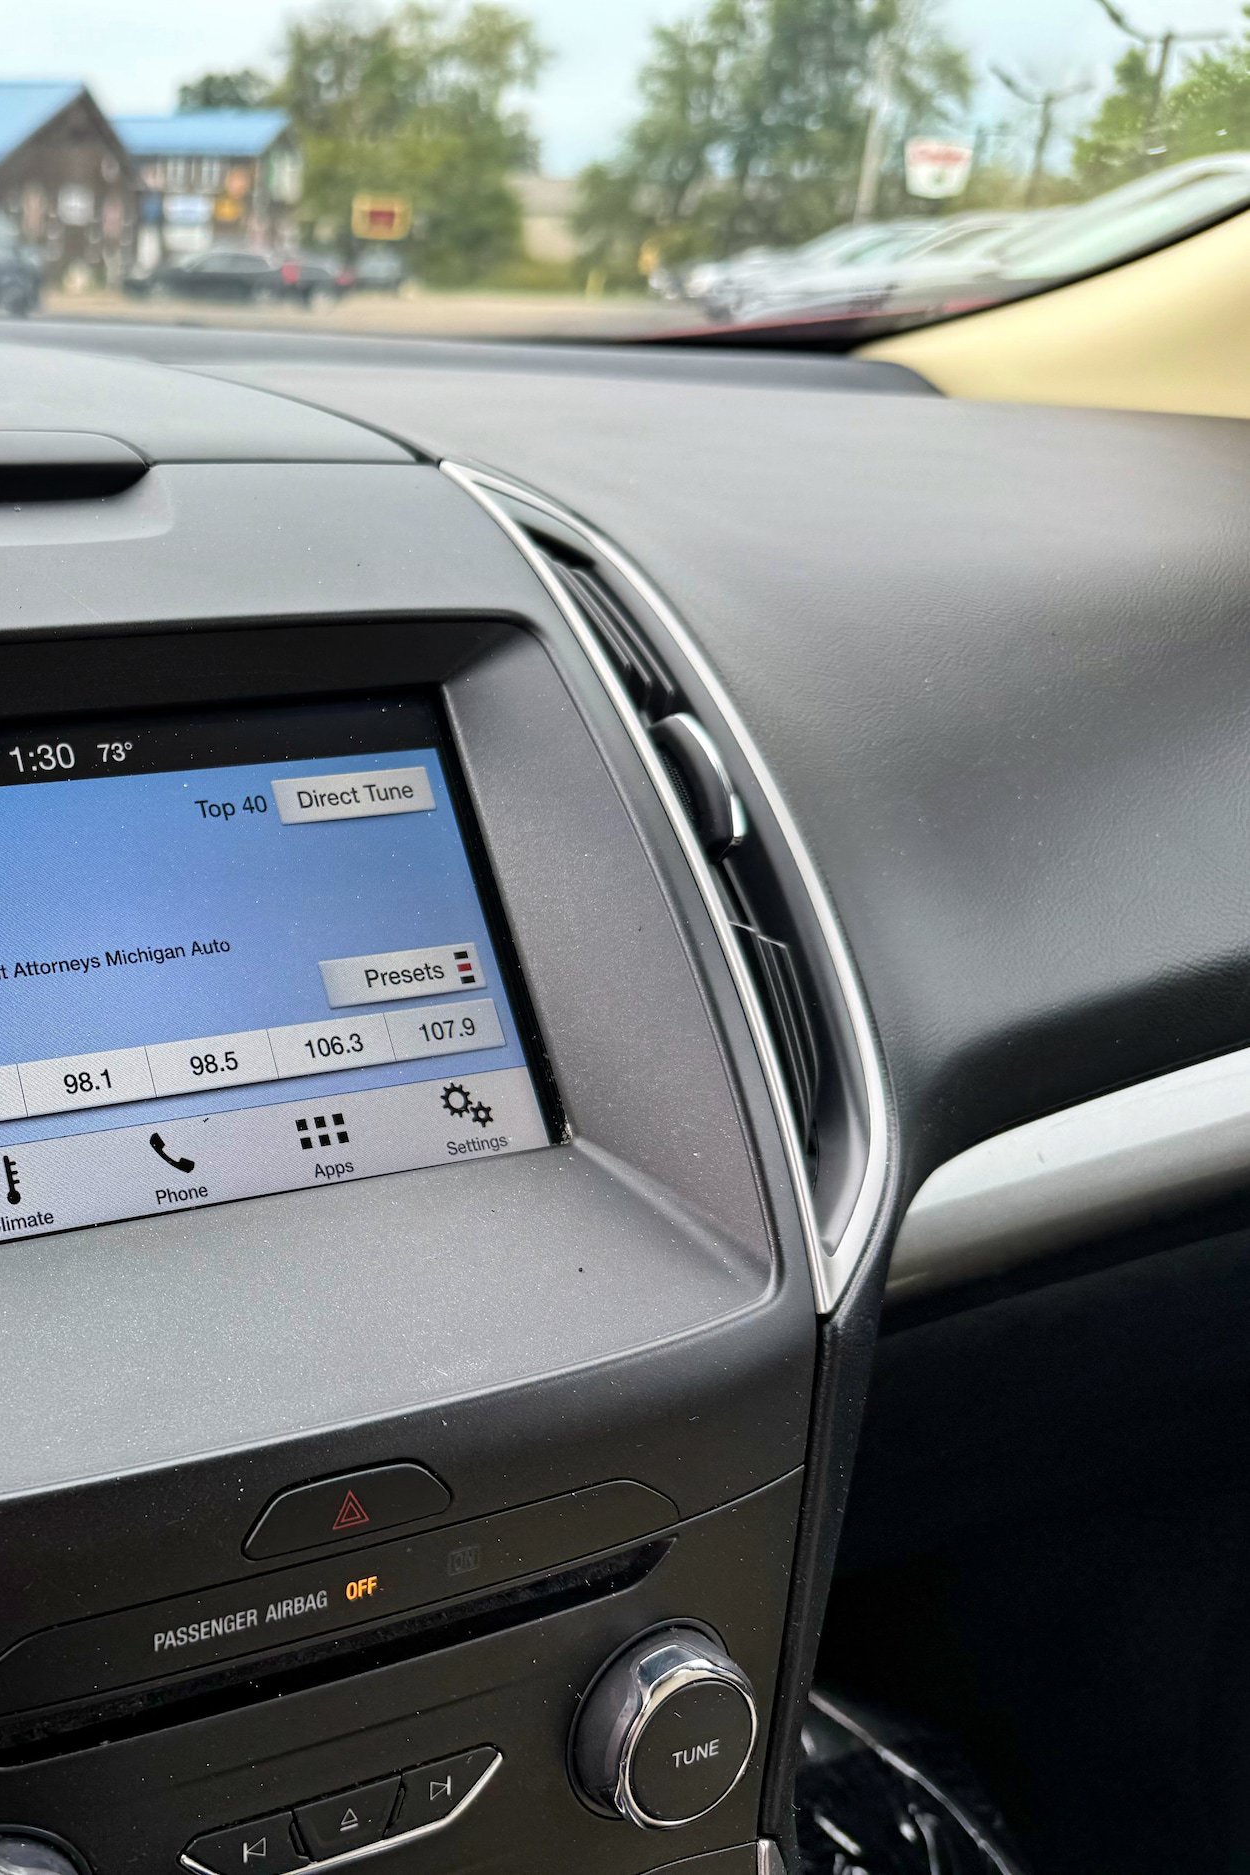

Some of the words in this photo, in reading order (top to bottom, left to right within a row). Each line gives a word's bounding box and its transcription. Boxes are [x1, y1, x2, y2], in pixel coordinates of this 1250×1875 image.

[9, 742, 76, 773] 1:30
[97, 742, 134, 764] 73°
[195, 799, 236, 821] Top
[241, 794, 268, 814] 40
[297, 785, 361, 810] Direct
[364, 783, 414, 804] Tune
[13, 955, 100, 978] Attorneys
[105, 941, 185, 965] Michigan
[190, 938, 230, 956] Auto
[365, 963, 444, 987] Presets
[418, 1018, 476, 1042] 107.9
[304, 1033, 364, 1058] 106.3
[190, 1051, 239, 1075] 98.5
[63, 1069, 112, 1094] 98.1
[446, 1132, 509, 1157] Settings
[314, 1159, 355, 1180] Apps
[156, 1183, 208, 1206] Phone
[153, 1609, 258, 1652] PASSENGER
[264, 1589, 328, 1624] AIRBAG
[345, 1576, 378, 1602] OFF
[672, 1739, 720, 1769] TUNE
